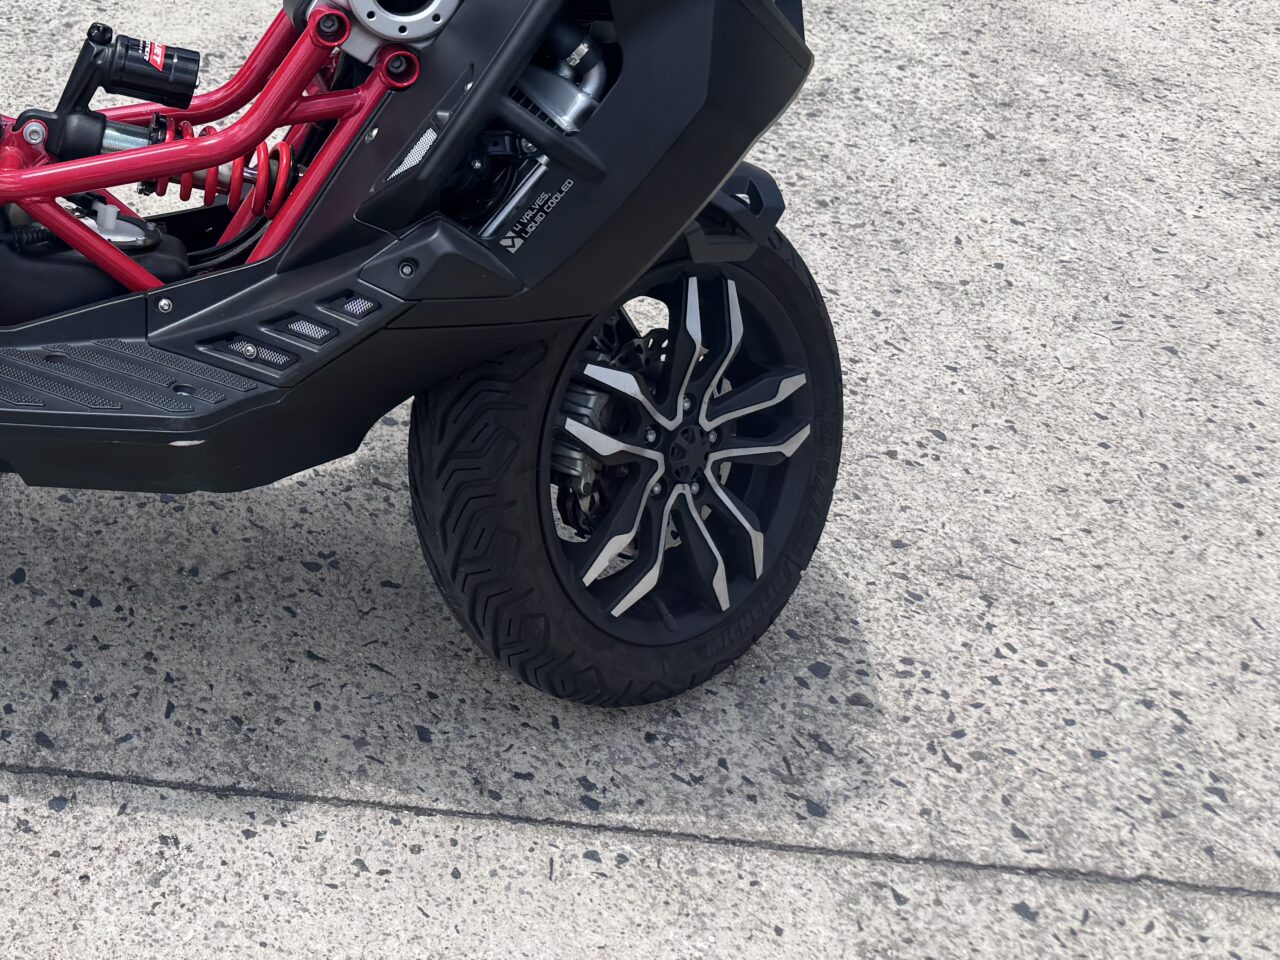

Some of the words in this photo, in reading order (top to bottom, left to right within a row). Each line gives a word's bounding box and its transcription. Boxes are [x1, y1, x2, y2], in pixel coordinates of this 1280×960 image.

[522, 211, 546, 238] LIQUID
[543, 178, 574, 213] COOLED
[513, 223, 523, 232] 4
